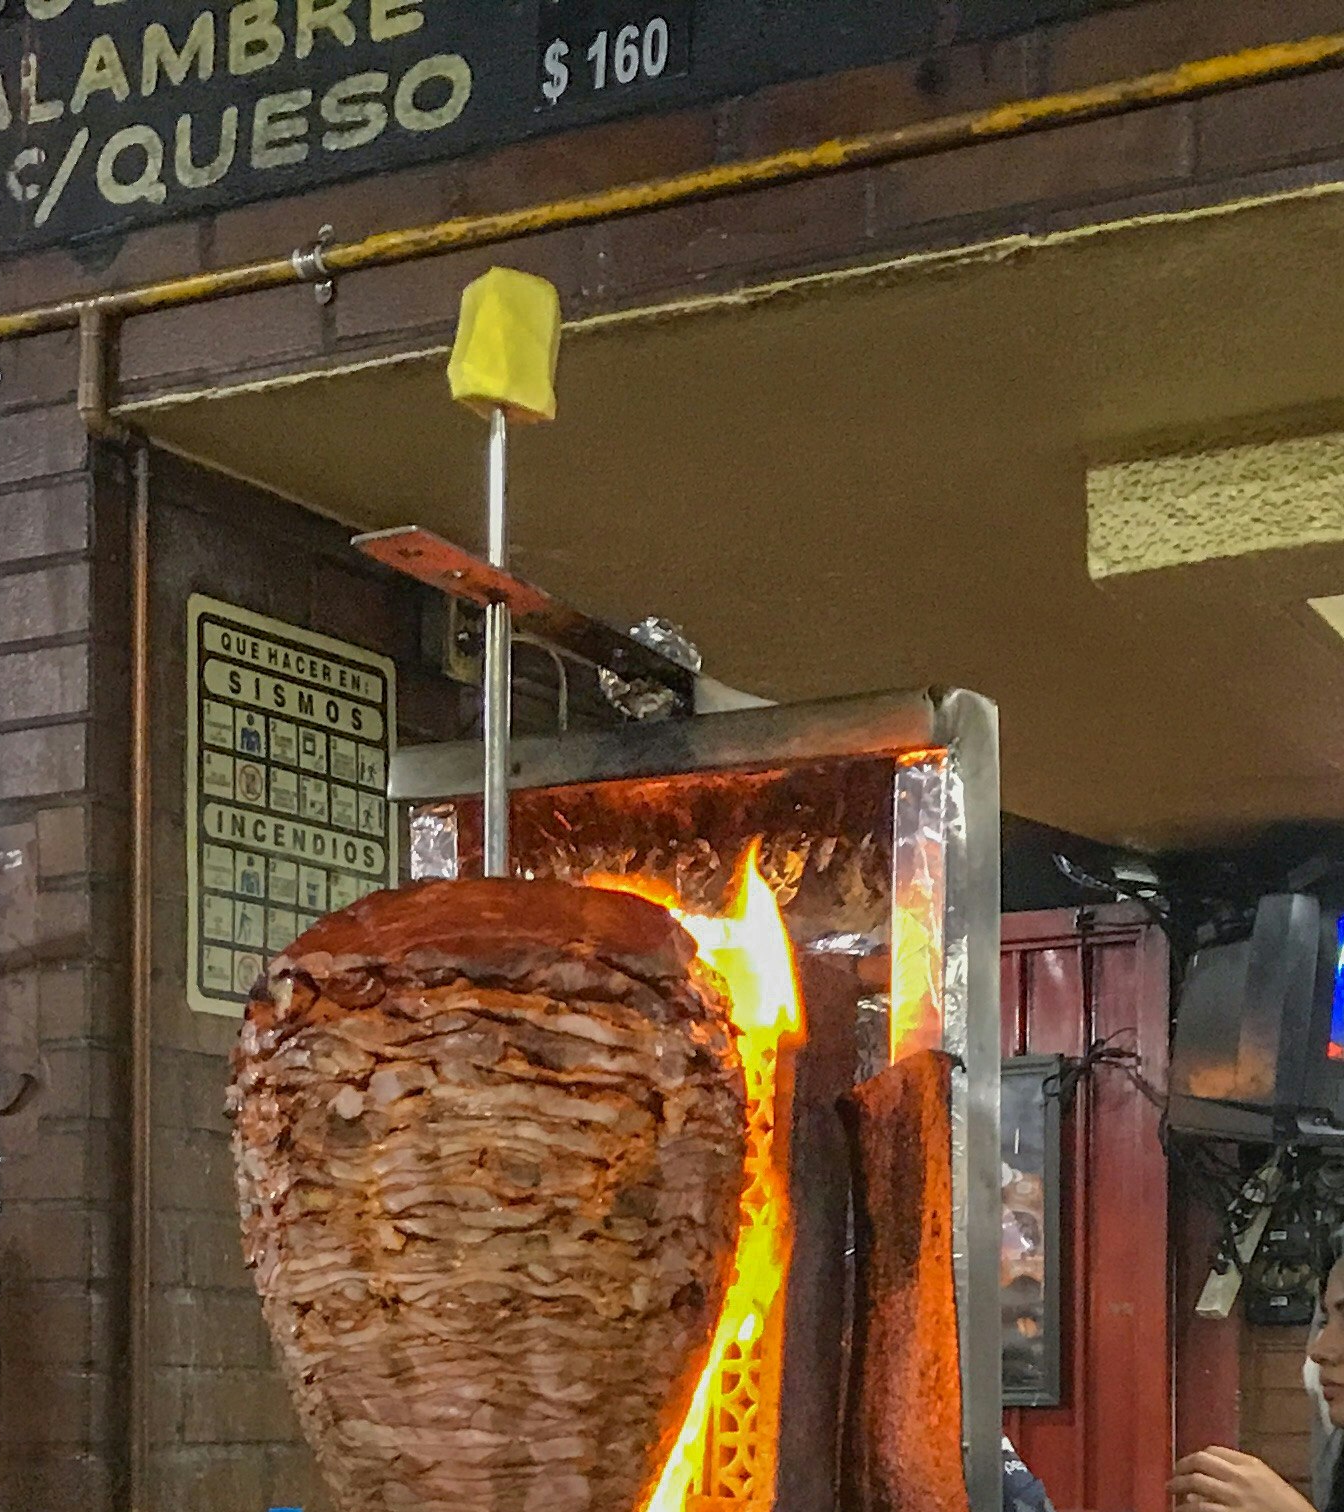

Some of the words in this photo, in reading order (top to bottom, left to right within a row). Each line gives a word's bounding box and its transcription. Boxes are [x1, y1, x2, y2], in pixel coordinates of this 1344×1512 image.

[221, 632, 260, 661] QUE
[268, 647, 332, 684] HACER
[228, 670, 362, 731] SISMOS
[216, 809, 375, 869] INCENDIOS
